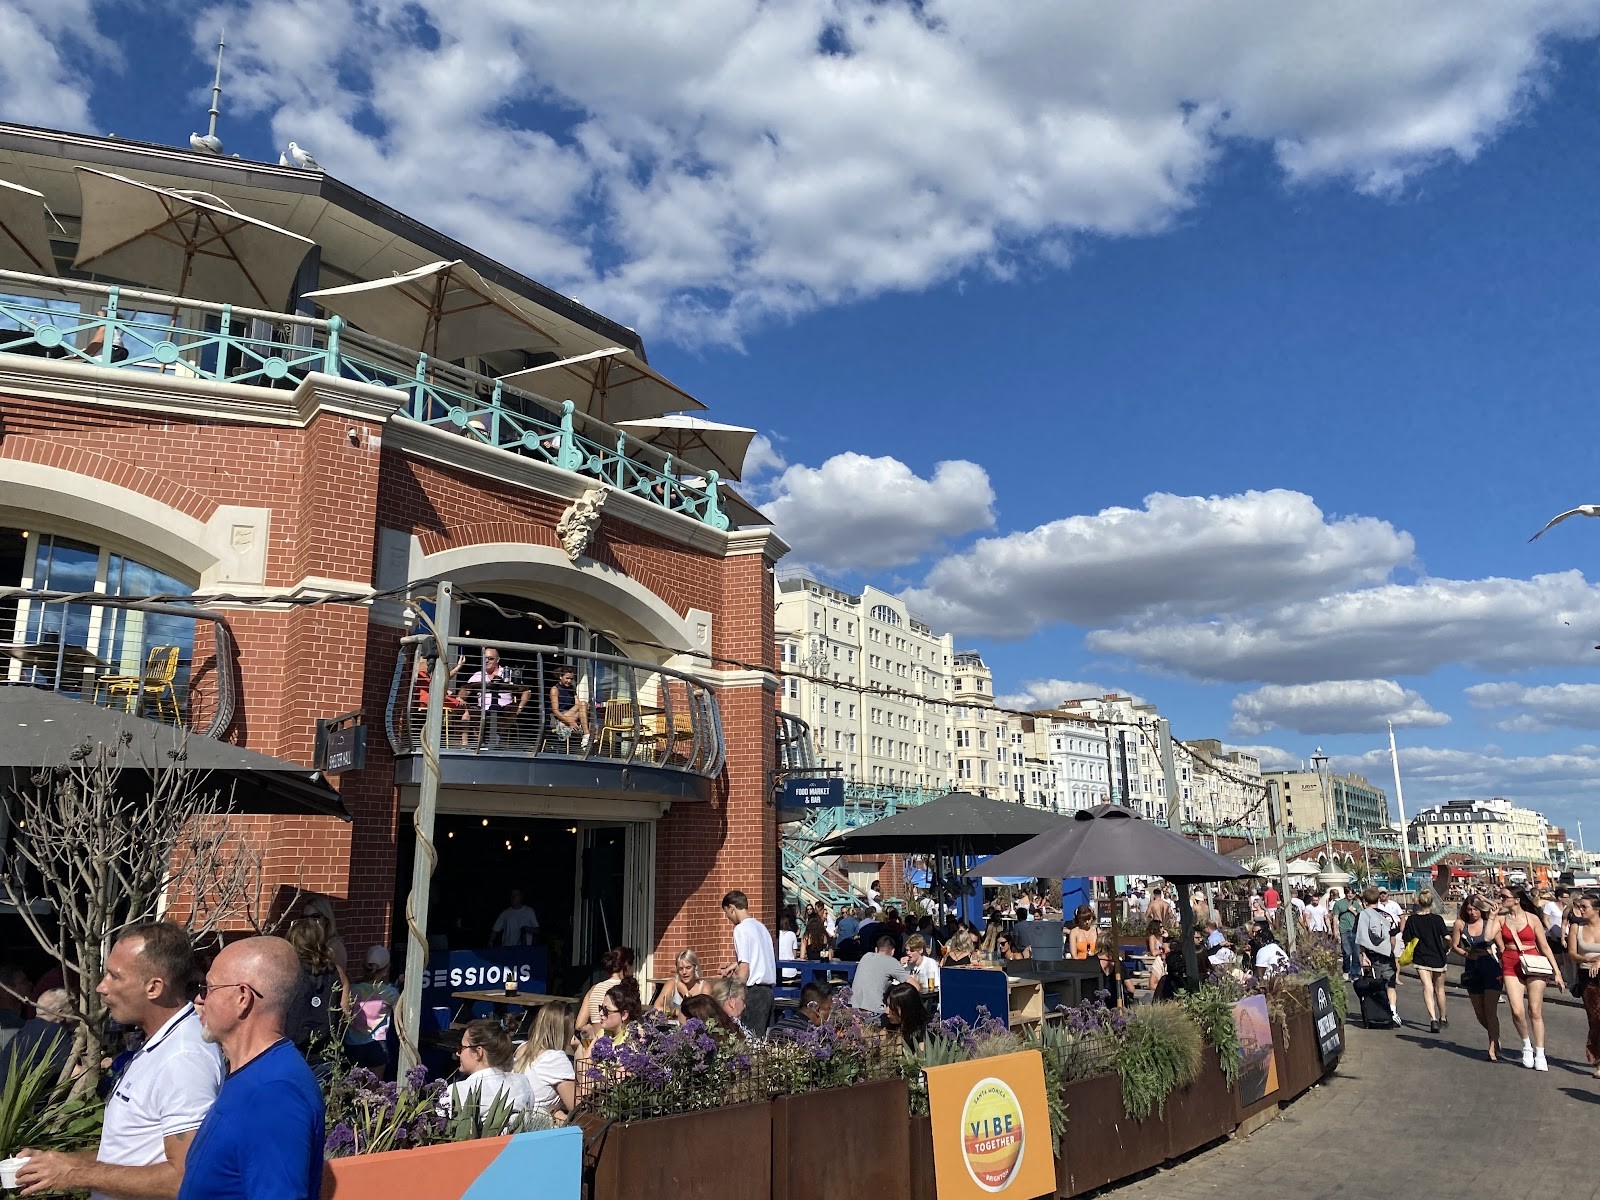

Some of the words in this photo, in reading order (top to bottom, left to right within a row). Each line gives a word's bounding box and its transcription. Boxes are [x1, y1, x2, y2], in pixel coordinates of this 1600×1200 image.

[795, 788, 808, 796] FOOD
[809, 787, 830, 796] MARKET
[804, 796, 810, 804] &
[810, 796, 821, 804] BAR
[974, 1090, 988, 1104] SANTA
[988, 1087, 1006, 1099] MONICA
[971, 1114, 1013, 1139] VIBE
[975, 1135, 1015, 1154] TOGETHER
[986, 1169, 1010, 1182] BRIGHTON
